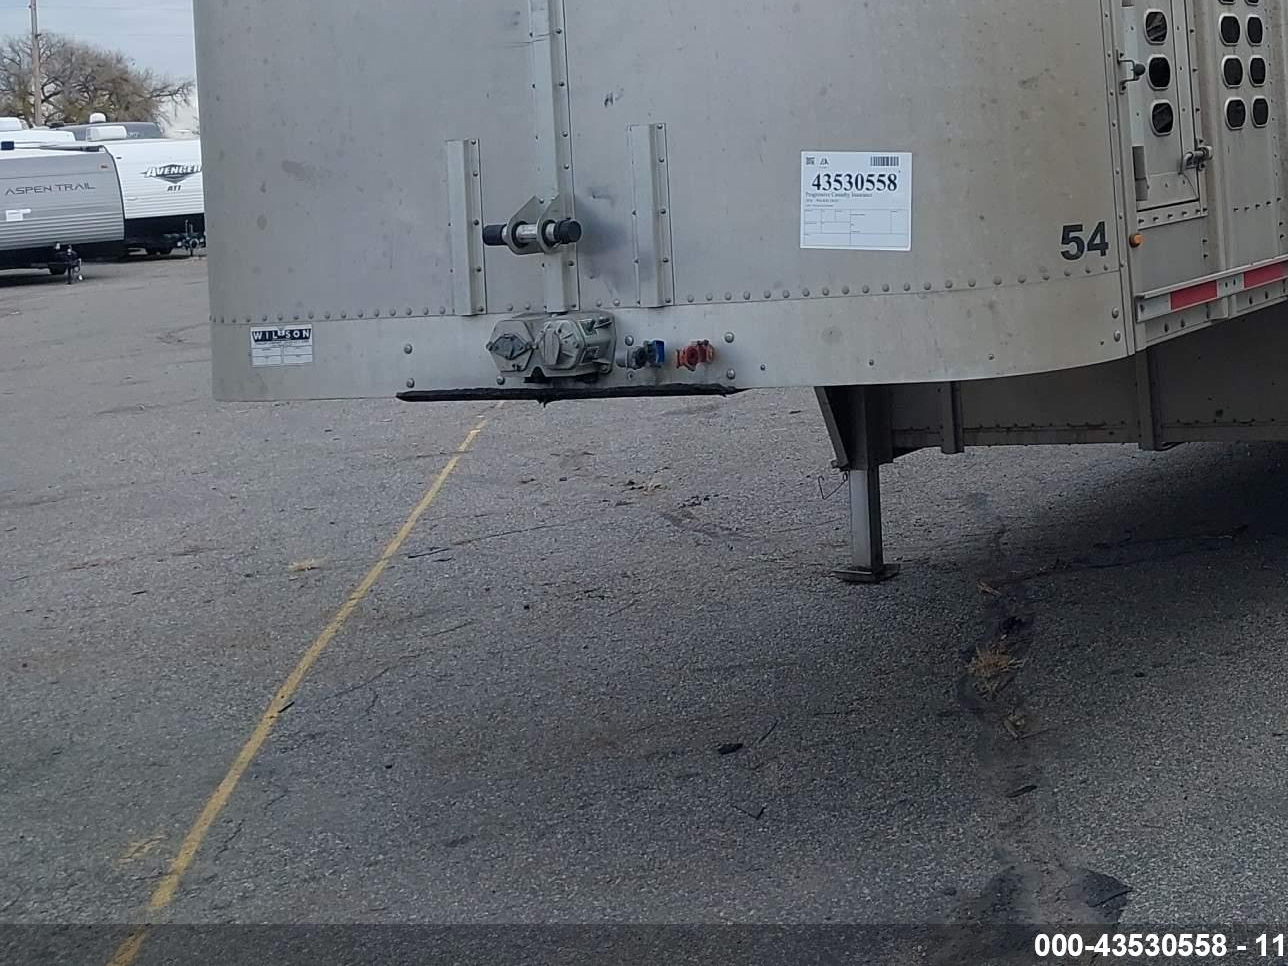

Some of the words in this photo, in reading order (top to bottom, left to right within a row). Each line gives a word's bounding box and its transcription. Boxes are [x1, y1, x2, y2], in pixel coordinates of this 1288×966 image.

[4, 184, 52, 195] ASPEN
[55, 182, 96, 191] TRAIL
[811, 173, 898, 191] 43530558
[1060, 221, 1109, 261] 54
[253, 329, 310, 341] WILSON
